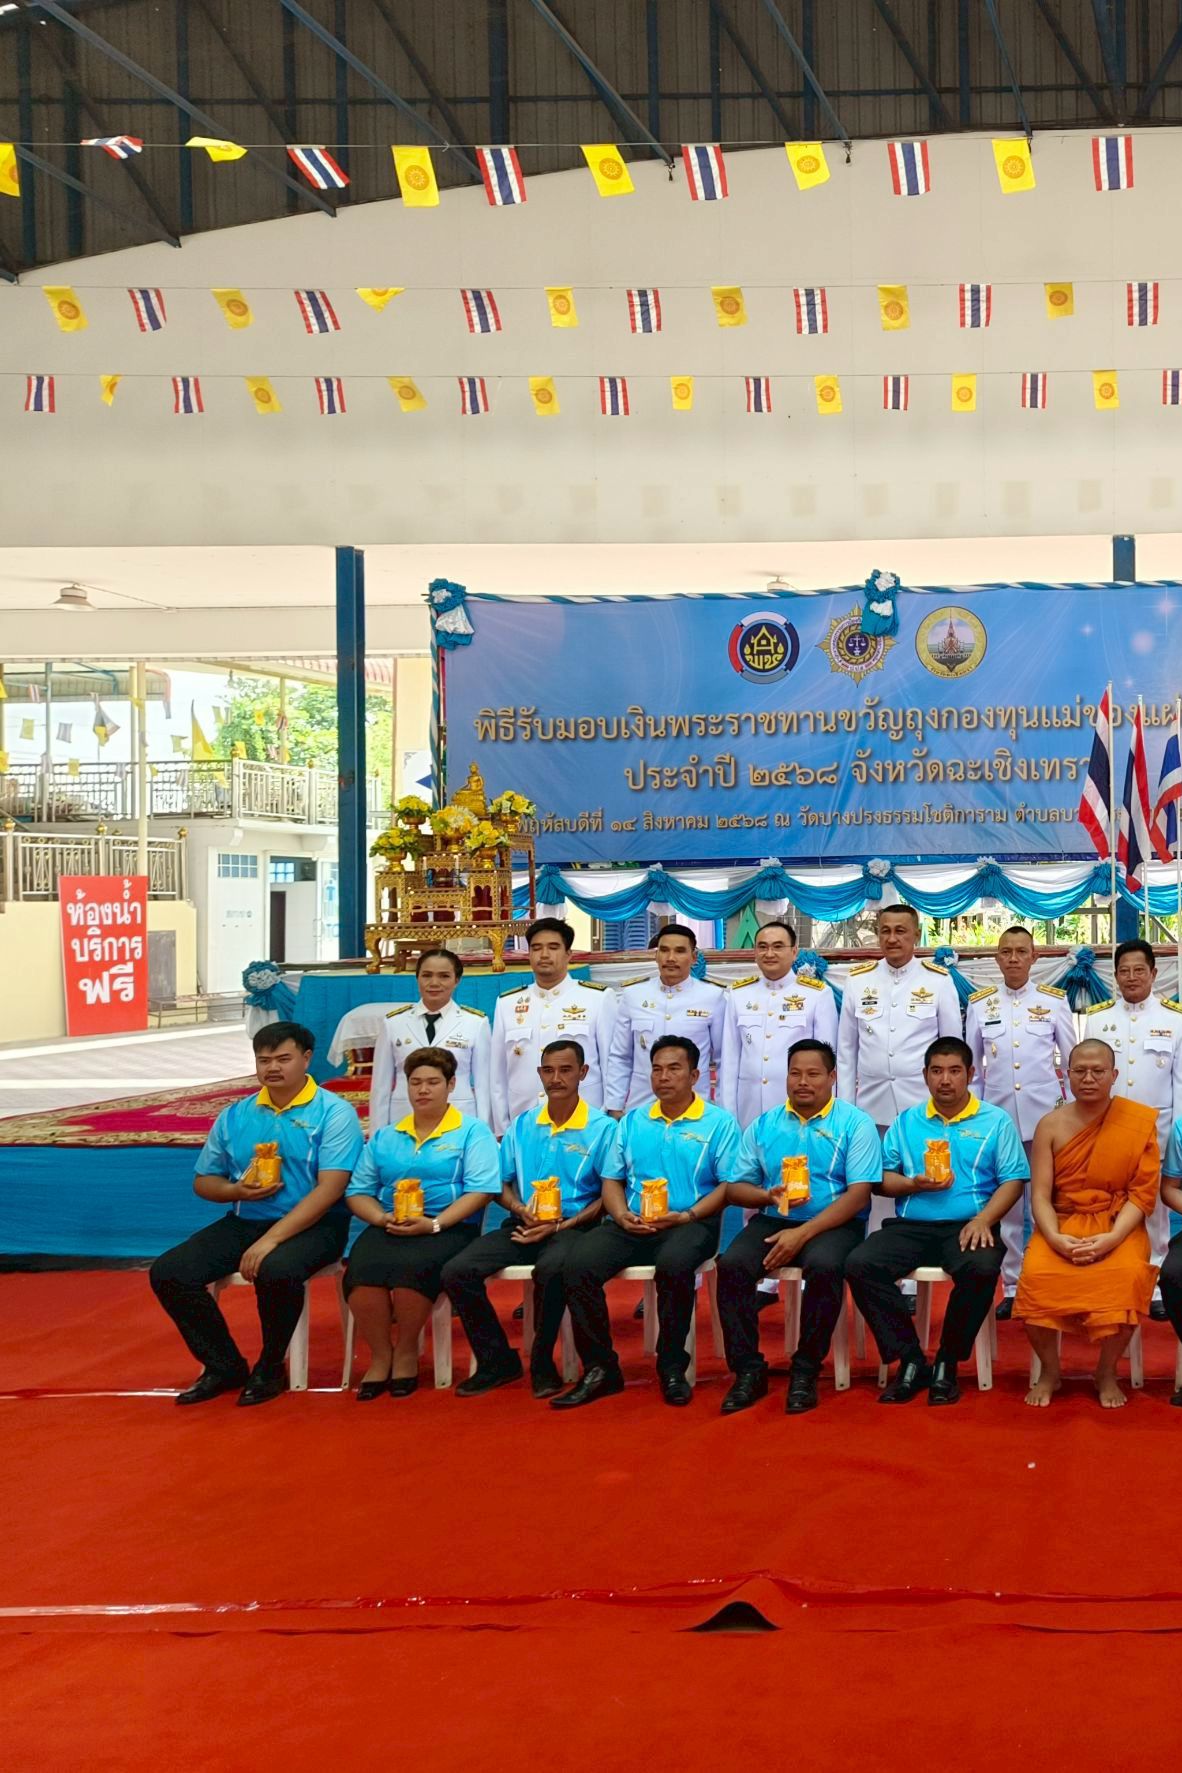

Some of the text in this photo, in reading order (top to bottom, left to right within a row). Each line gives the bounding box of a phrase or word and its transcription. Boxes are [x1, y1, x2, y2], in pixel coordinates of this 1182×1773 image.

[623, 753, 736, 791] ประจำปี
[749, 760, 838, 788] ๒๕๖๘
[610, 817, 638, 832] ๑๔
[642, 811, 709, 832] สิงหาคม
[716, 814, 767, 829] ๒๕๖๘
[774, 812, 790, 828] ณ
[66, 879, 141, 926] ห้องน้ำ
[71, 926, 143, 962] บริการ
[78, 961, 135, 1005] ฟรี
